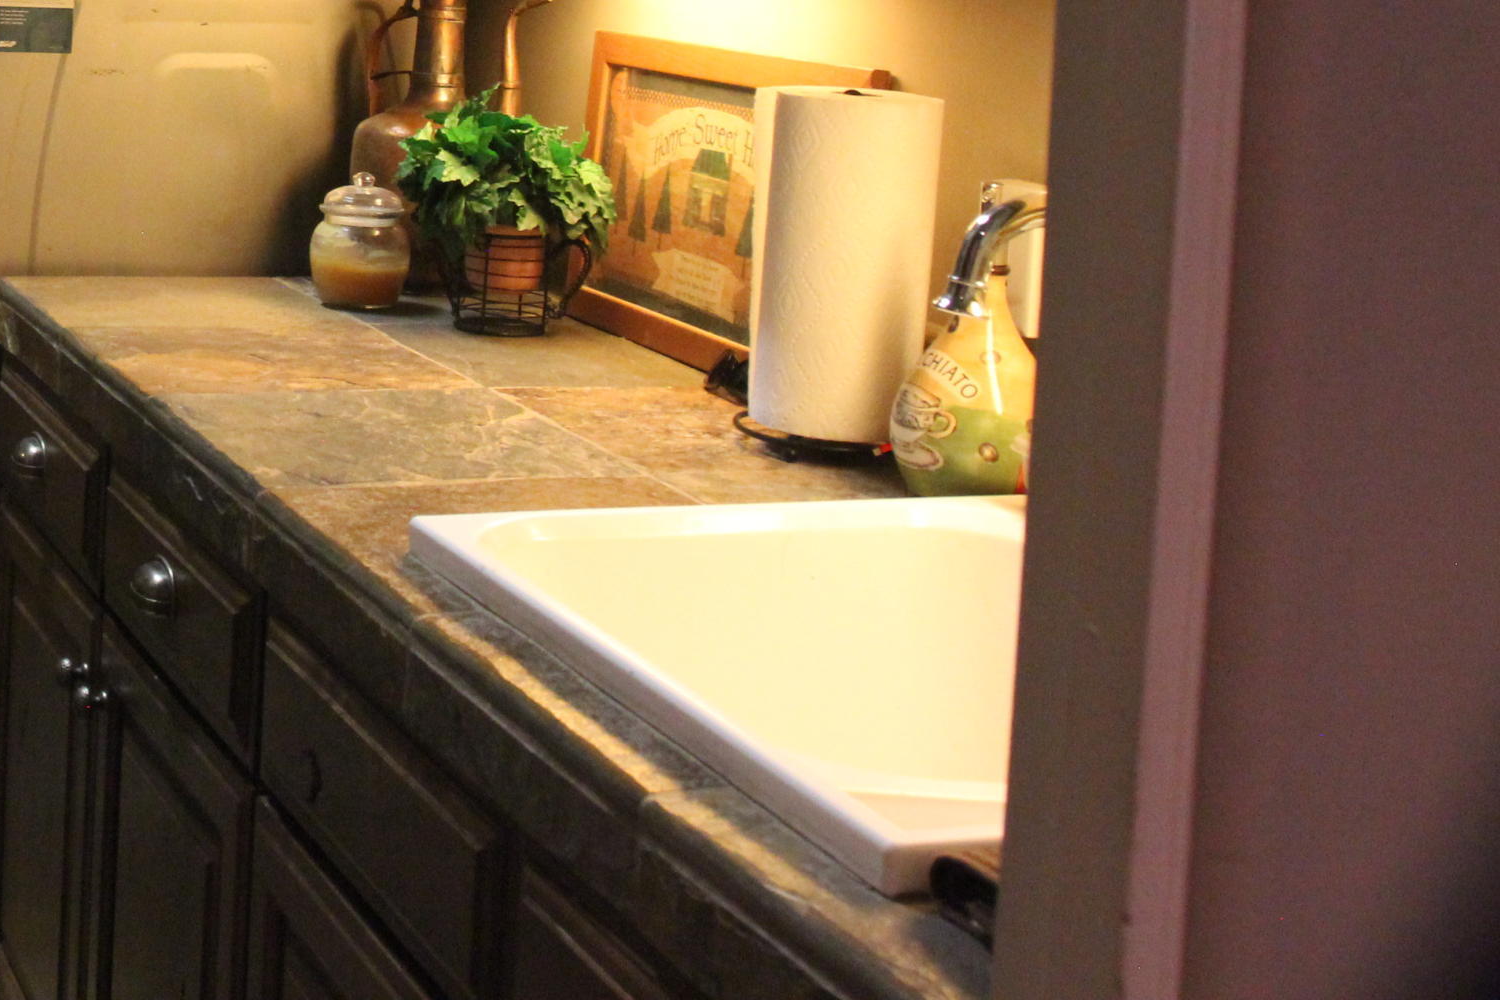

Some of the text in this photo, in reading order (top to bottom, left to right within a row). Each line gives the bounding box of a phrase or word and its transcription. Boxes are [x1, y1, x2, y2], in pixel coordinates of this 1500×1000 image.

[651, 126, 687, 166] Home
[693, 113, 738, 155] Sweet
[921, 352, 978, 398] CHIATO
